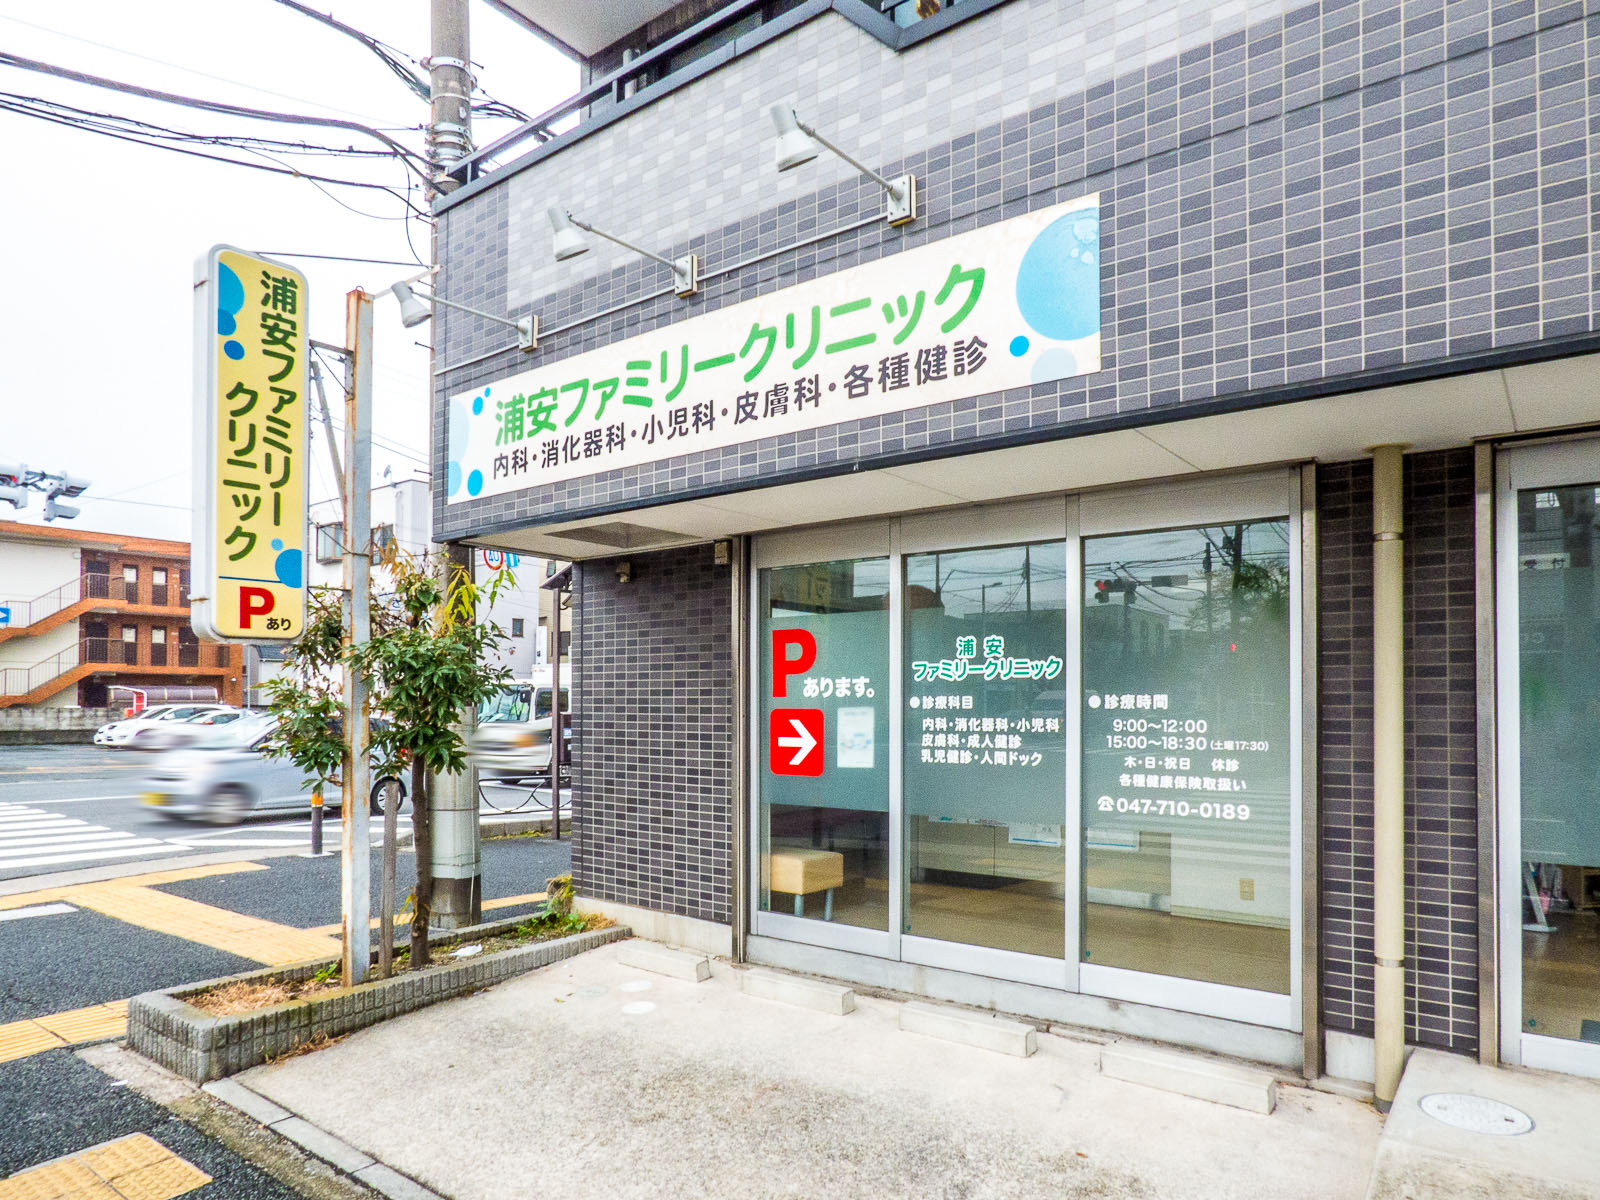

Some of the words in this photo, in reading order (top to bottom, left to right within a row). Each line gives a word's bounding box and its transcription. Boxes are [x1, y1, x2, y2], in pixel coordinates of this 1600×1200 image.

[495, 264, 985, 446] 浦安ファミリークリニック
[260, 270, 298, 526] 浦安ファミリー
[223, 382, 261, 561] クリニック
[239, 586, 275, 629] P
[266, 617, 292, 631] あり
[772, 629, 817, 698] P
[803, 676, 875, 698] あります。
[912, 656, 1063, 681] ファミリークリニック
[922, 717, 1060, 733] 内科・消化器科・小児科
[921, 734, 1022, 749] 皮膚科・成人健診
[921, 750, 1042, 766] 乳児健診・人間ドック
[1211, 758, 1240, 772] 休診
[1119, 773, 1247, 791] 各種健康保険取扱い
[1117, 797, 1250, 820] 047-710-0189
